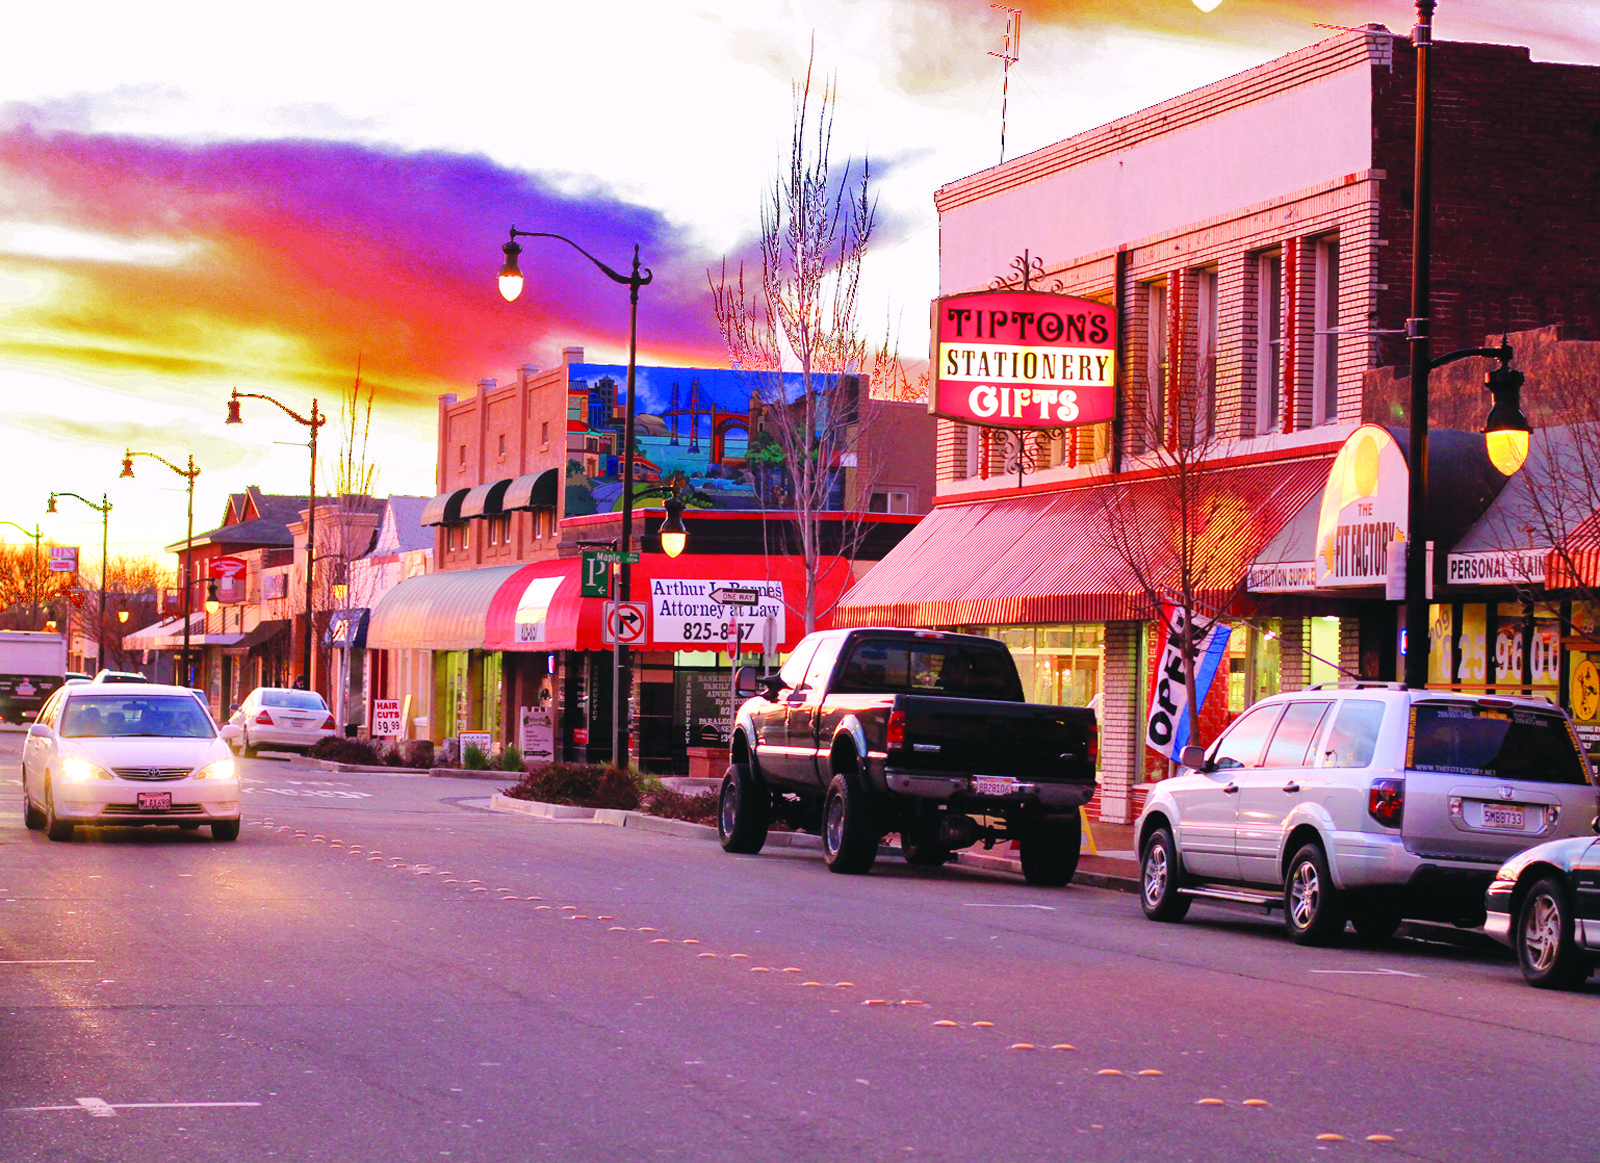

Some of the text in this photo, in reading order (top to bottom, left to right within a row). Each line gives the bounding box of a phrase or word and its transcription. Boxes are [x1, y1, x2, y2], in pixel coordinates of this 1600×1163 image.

[948, 308, 1109, 344] TIPTON'S
[947, 349, 1109, 381] STATIONERY
[968, 385, 1080, 422] GIFTS
[1358, 503, 1373, 516] THE
[596, 552, 621, 563] Maple
[1336, 524, 1351, 577] FIT
[585, 558, 606, 587] P
[1251, 568, 1287, 588] NUTRITION
[1450, 557, 1507, 580] PERSONAL
[653, 580, 706, 596] Arthur
[728, 581, 782, 598] Bnes
[722, 593, 737, 601] ONE
[659, 599, 779, 619] Attorney at Law
[683, 622, 755, 641] 825-857
[376, 702, 398, 710] HAIR
[715, 698, 723, 706] By
[376, 711, 400, 719] CUTS
[377, 721, 400, 734] $9.99
